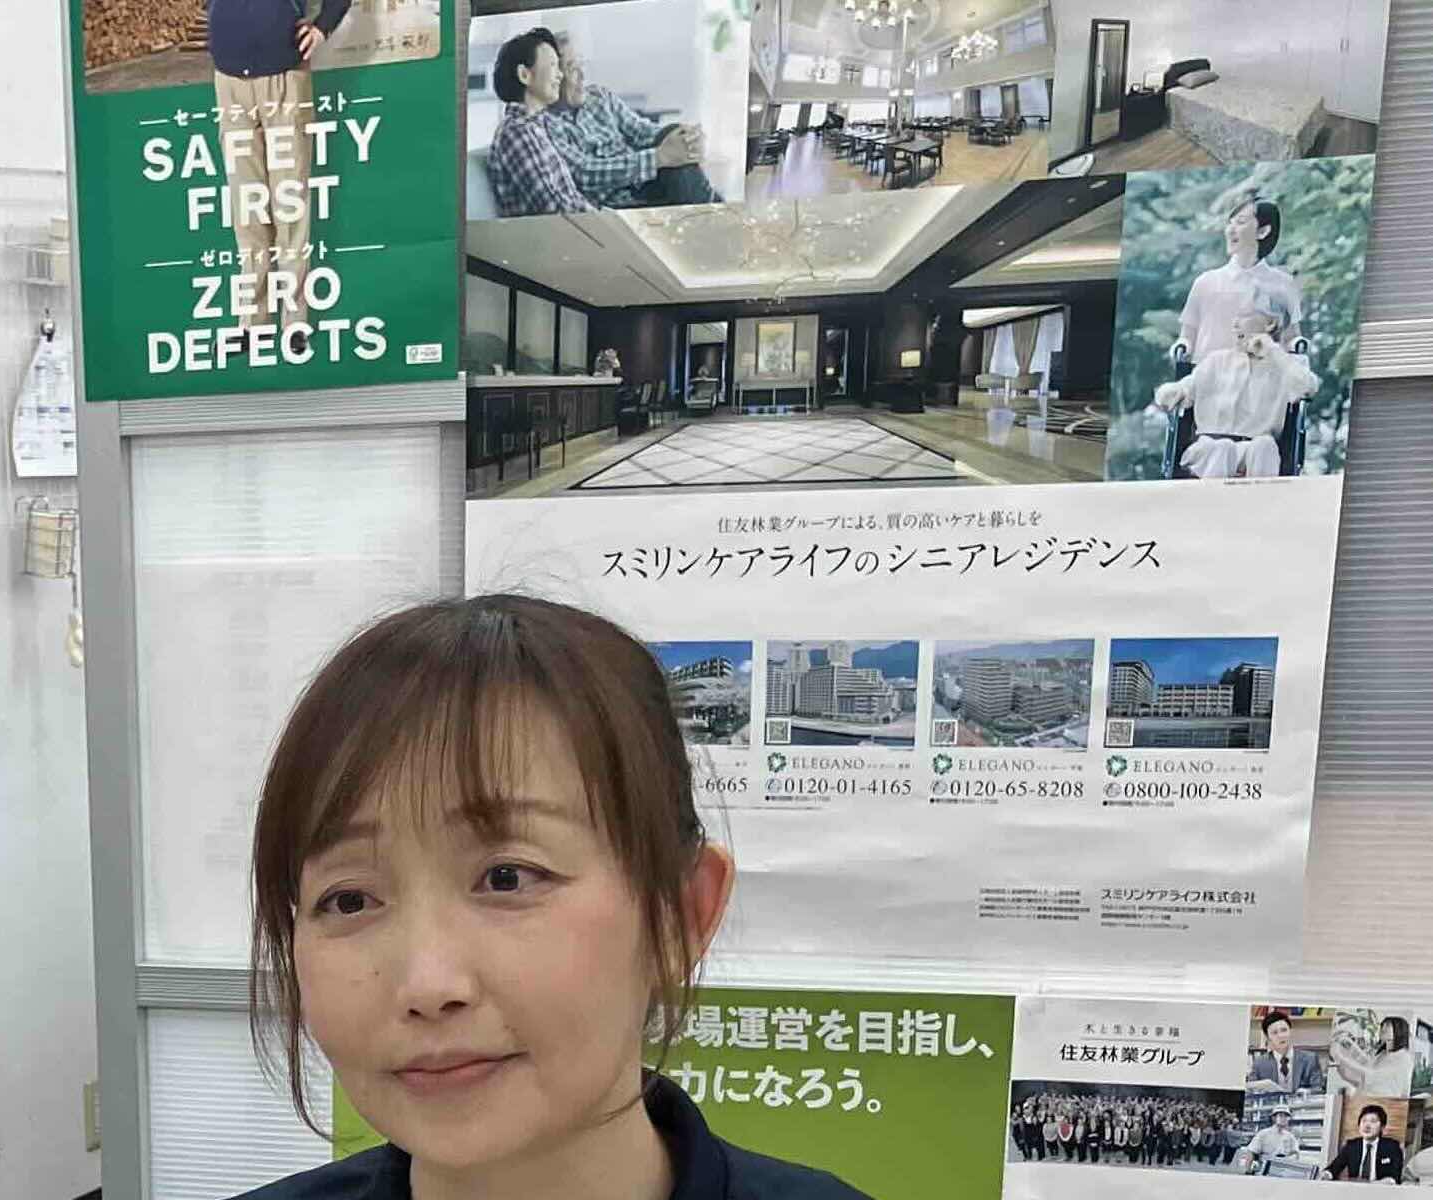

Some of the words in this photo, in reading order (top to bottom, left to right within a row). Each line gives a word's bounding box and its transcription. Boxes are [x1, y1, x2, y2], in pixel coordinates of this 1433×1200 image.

[173, 92, 348, 127] セーフティファースト
[142, 116, 381, 181] SAFETY
[188, 175, 340, 230] FIRST
[200, 240, 328, 268] ゼロディフェクト
[192, 267, 342, 319] ZERO
[147, 317, 388, 374] DEFECTS
[602, 536, 1162, 579] スミリンケアライフのシニアレジデンス
[792, 759, 864, 770] ELEGANO
[958, 759, 1034, 771] ELEGANO
[1133, 761, 1214, 773] ELEGANO
[784, 778, 912, 796] 0120-01-4165
[950, 780, 1084, 798] 0120-65-8208
[1124, 782, 1263, 801] 0800-100-2438
[1102, 888, 1256, 904] スミリンケアライフ株式会社
[1060, 1044, 1205, 1066] 住友林業グループ
[645, 1062, 883, 1113] 力になろう。
